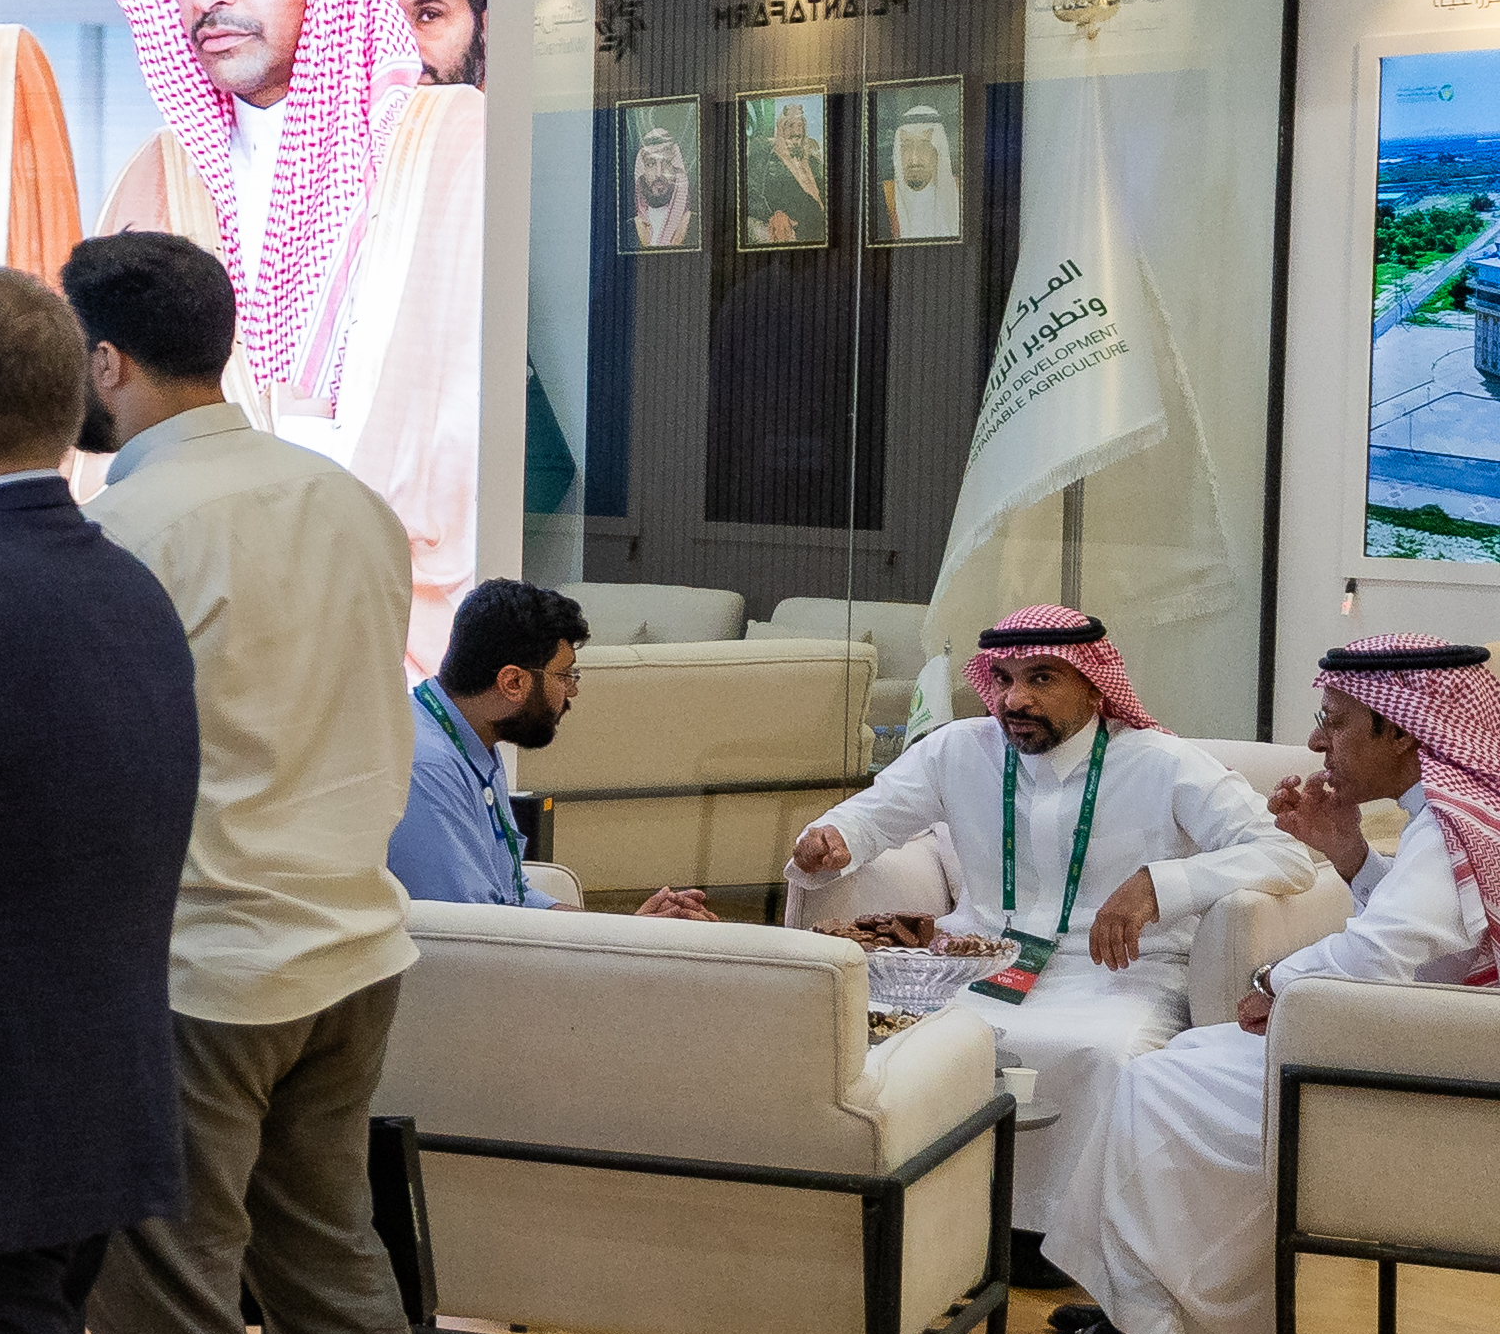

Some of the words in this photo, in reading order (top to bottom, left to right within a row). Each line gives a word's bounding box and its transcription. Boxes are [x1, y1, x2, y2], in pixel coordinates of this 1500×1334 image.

[1007, 259, 1083, 340] المركز
[1022, 297, 1108, 358] وتطوير
[1012, 322, 1119, 392] DEVELOPMENT
[1029, 339, 1130, 400] AGRICULTURE
